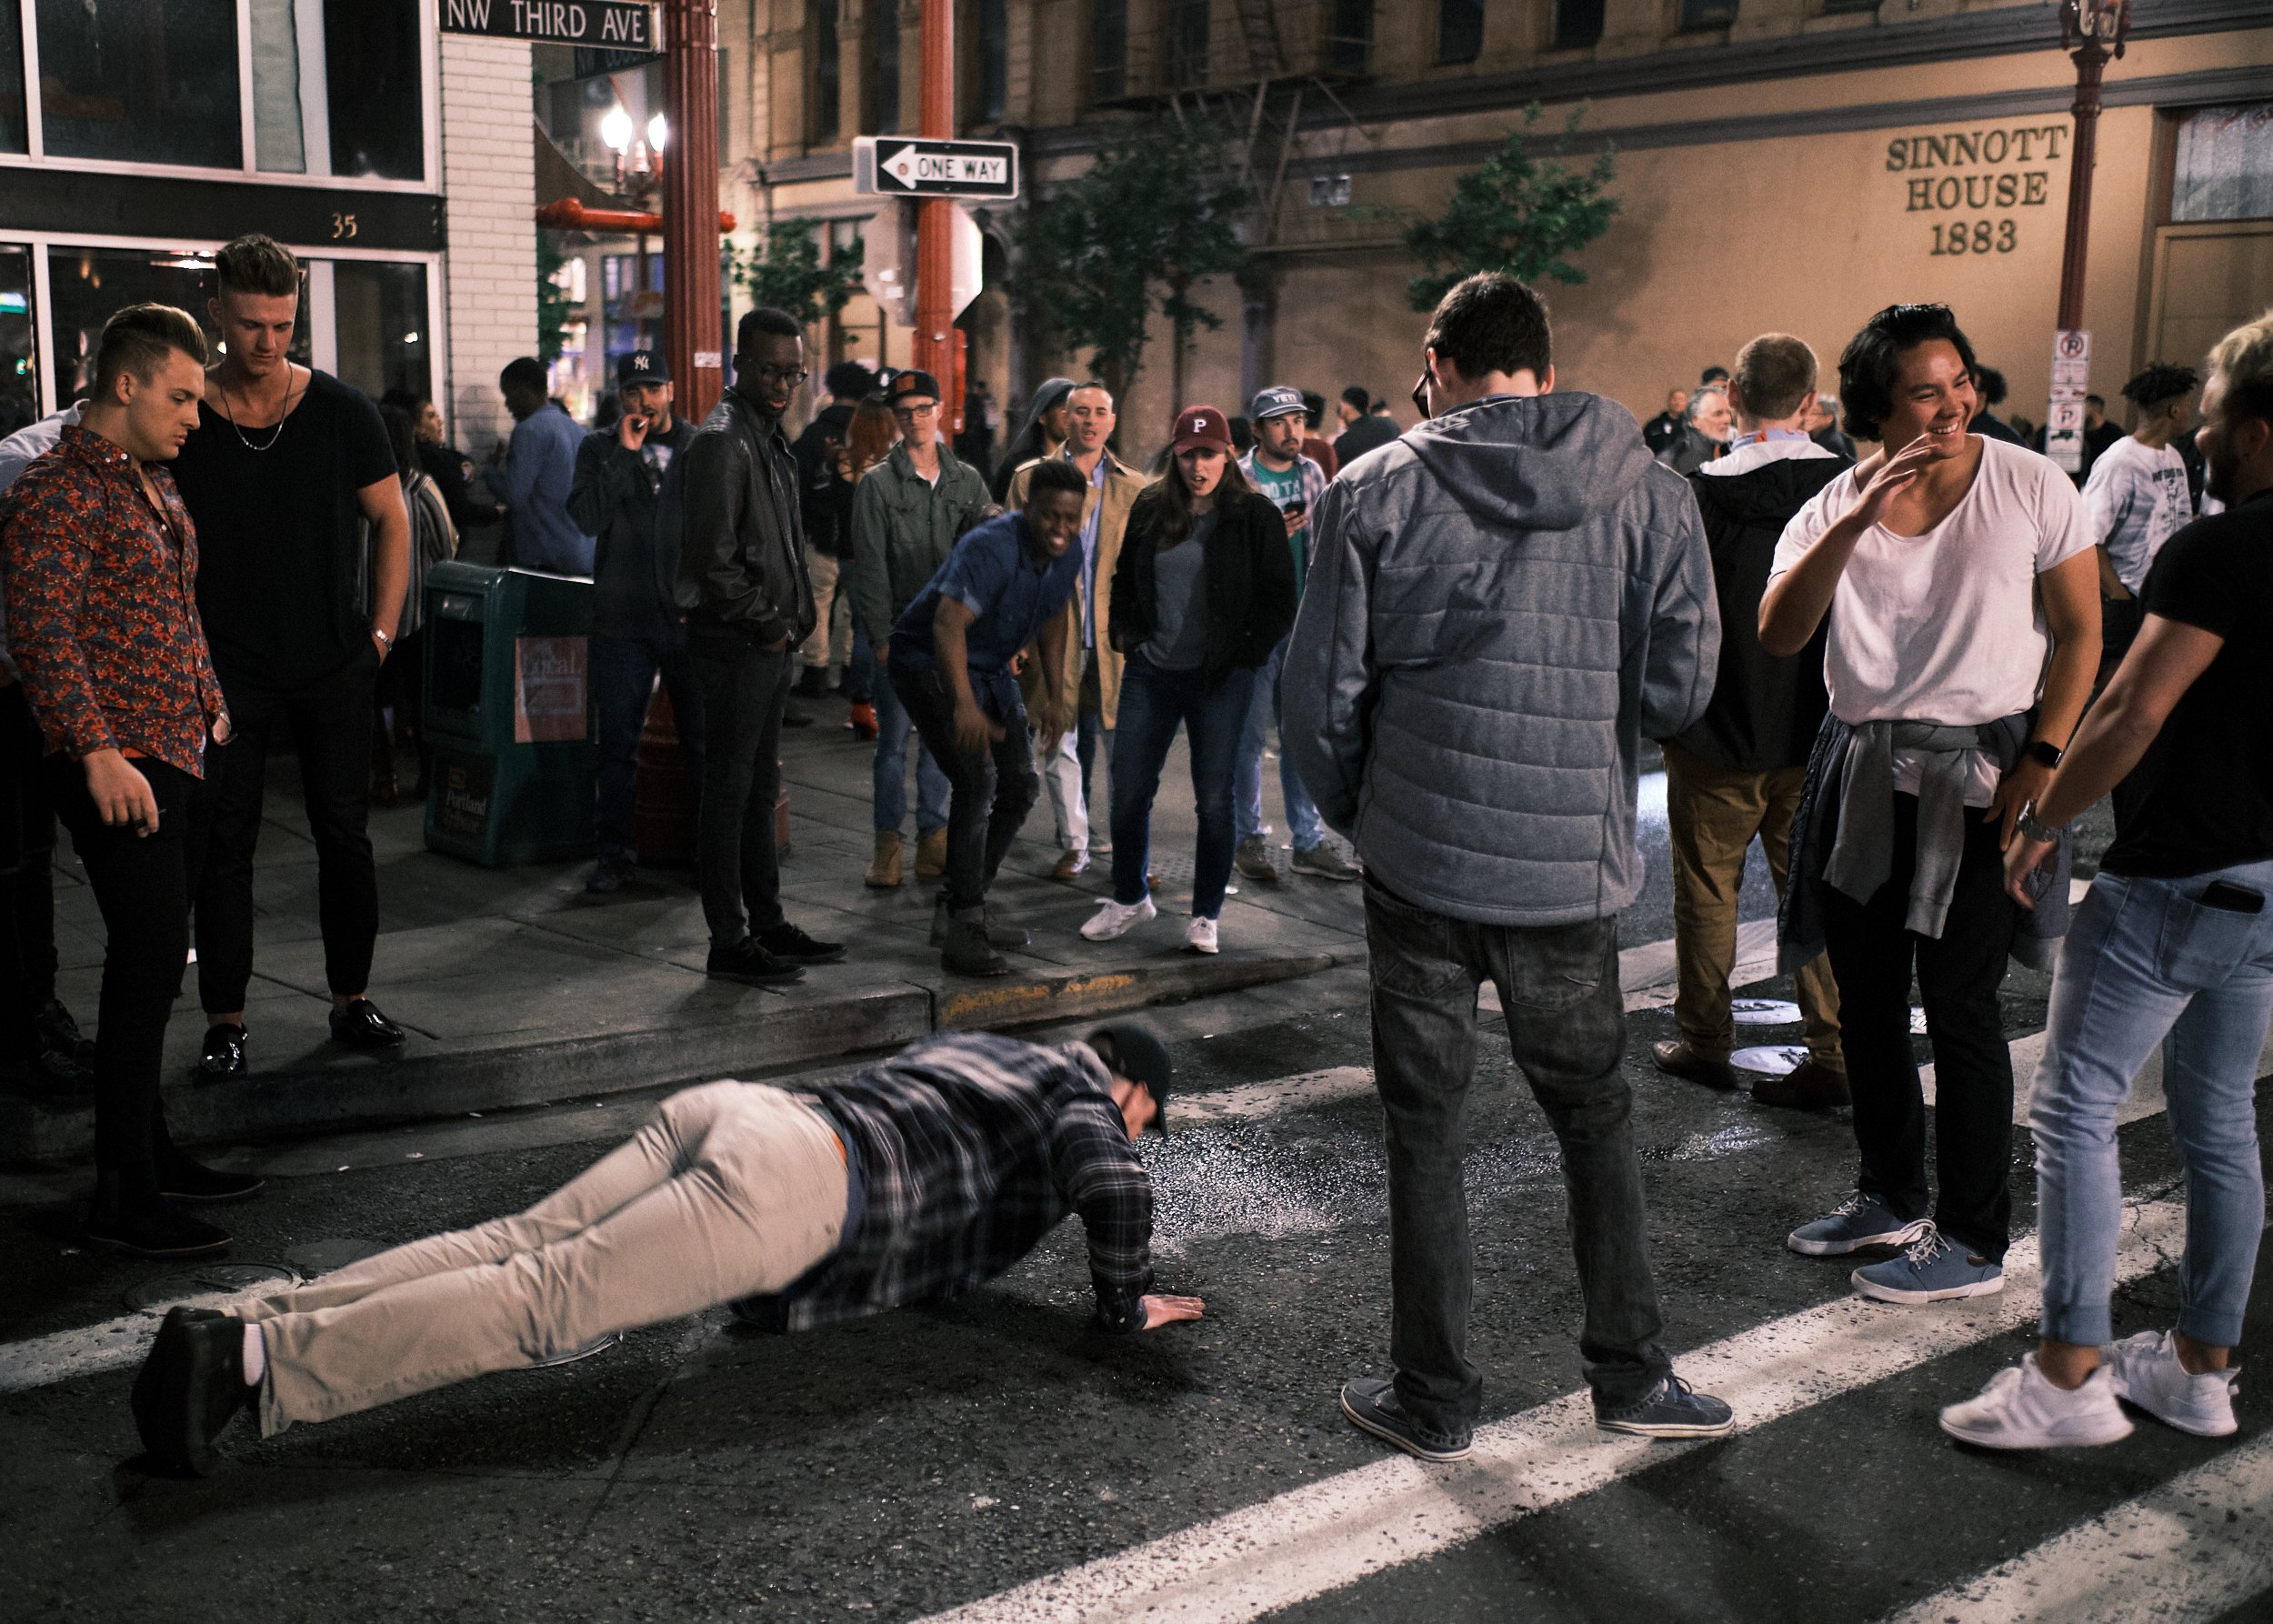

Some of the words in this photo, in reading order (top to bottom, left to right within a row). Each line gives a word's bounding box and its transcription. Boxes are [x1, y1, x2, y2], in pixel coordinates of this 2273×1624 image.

[447, 0, 491, 31] NW
[510, 1, 587, 38] THIRD
[601, 8, 646, 44] AVE
[1886, 125, 2068, 172] SINNOTT
[918, 157, 956, 178] ONE
[962, 159, 1000, 180] WAY
[1906, 171, 2049, 212] HOUSE
[331, 211, 358, 238] 35
[1929, 218, 2018, 256] 1883
[633, 356, 650, 371] NY
[1193, 418, 1207, 433] P
[446, 790, 487, 817] Portland
